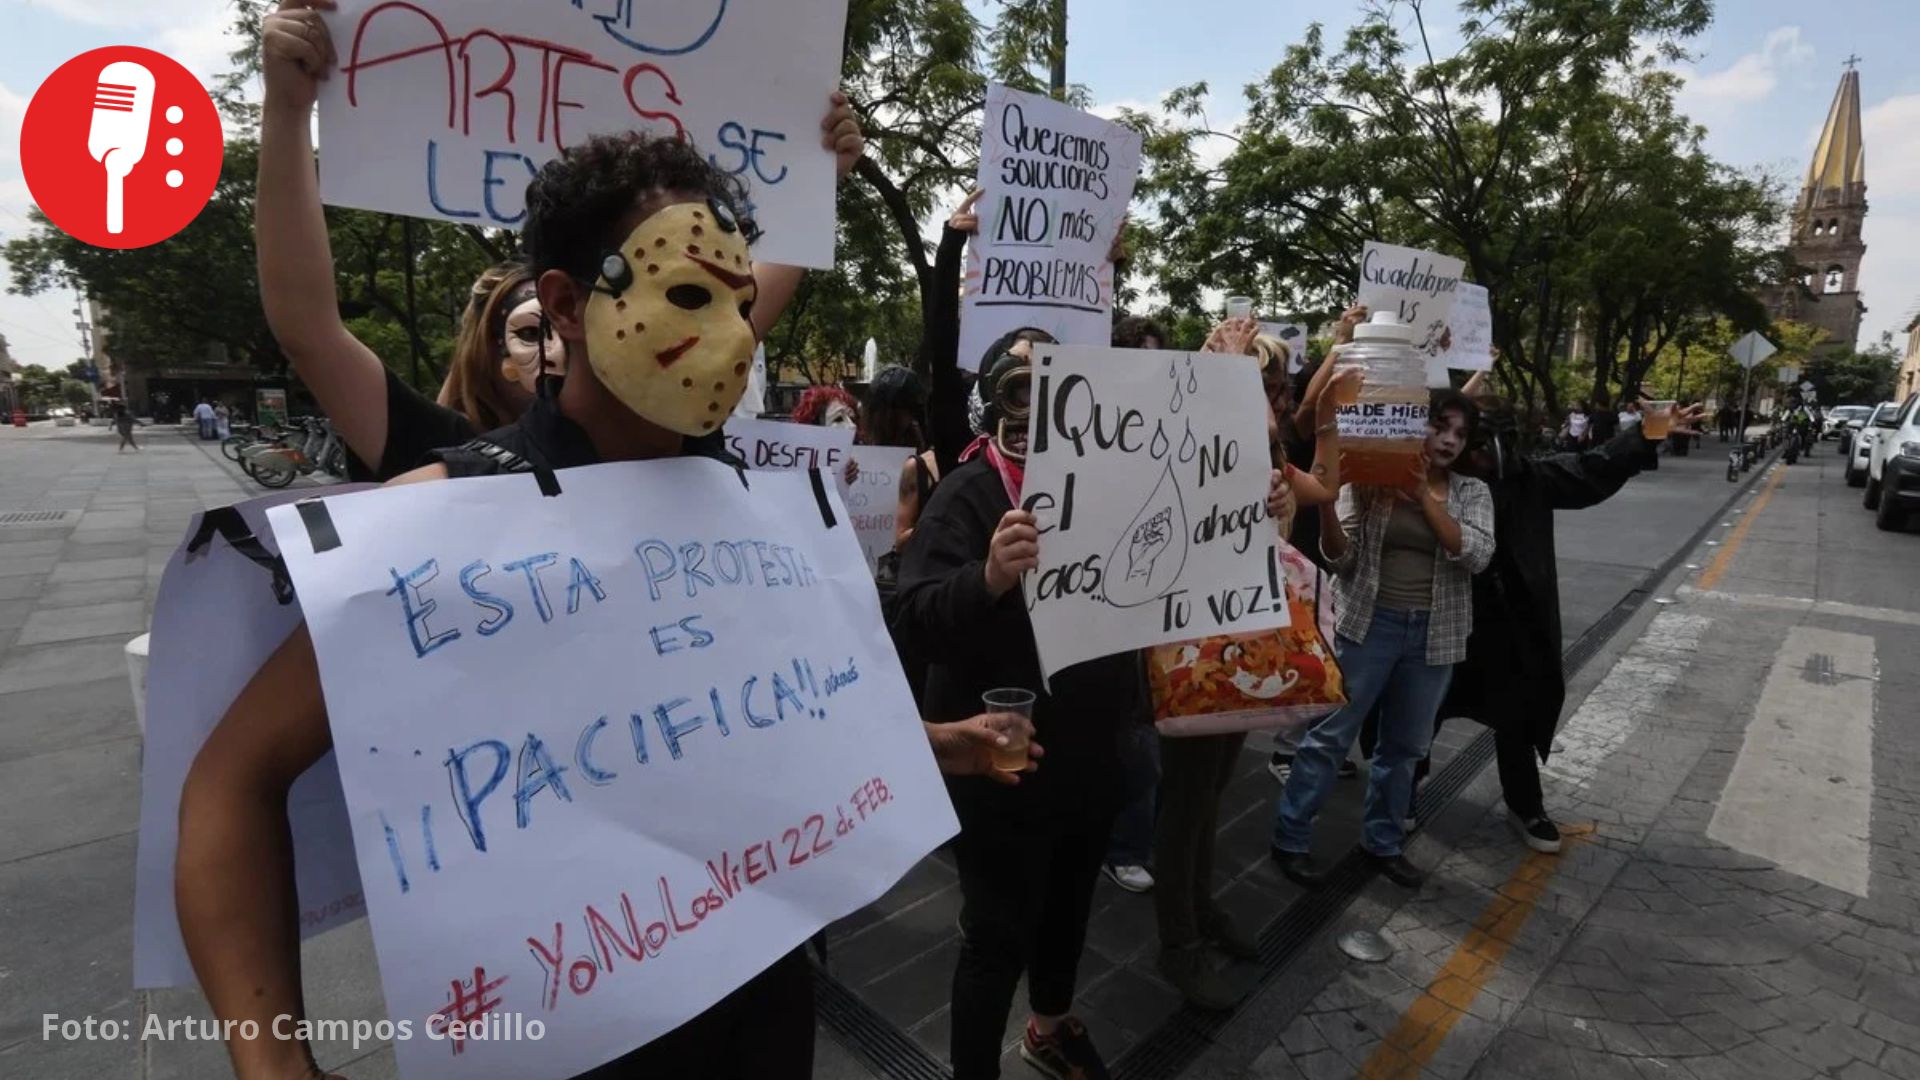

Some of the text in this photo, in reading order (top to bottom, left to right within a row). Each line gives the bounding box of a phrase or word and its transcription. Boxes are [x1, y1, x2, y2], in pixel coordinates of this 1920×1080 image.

[341, 1, 683, 152] ARTES
[1001, 103, 1110, 170] Queremos
[996, 196, 1095, 242] NO más
[981, 257, 1101, 305] PROBLEMAS
[1362, 403, 1386, 418] DE
[386, 539, 817, 659] ESTA PROTESTA
[649, 614, 715, 656] ES
